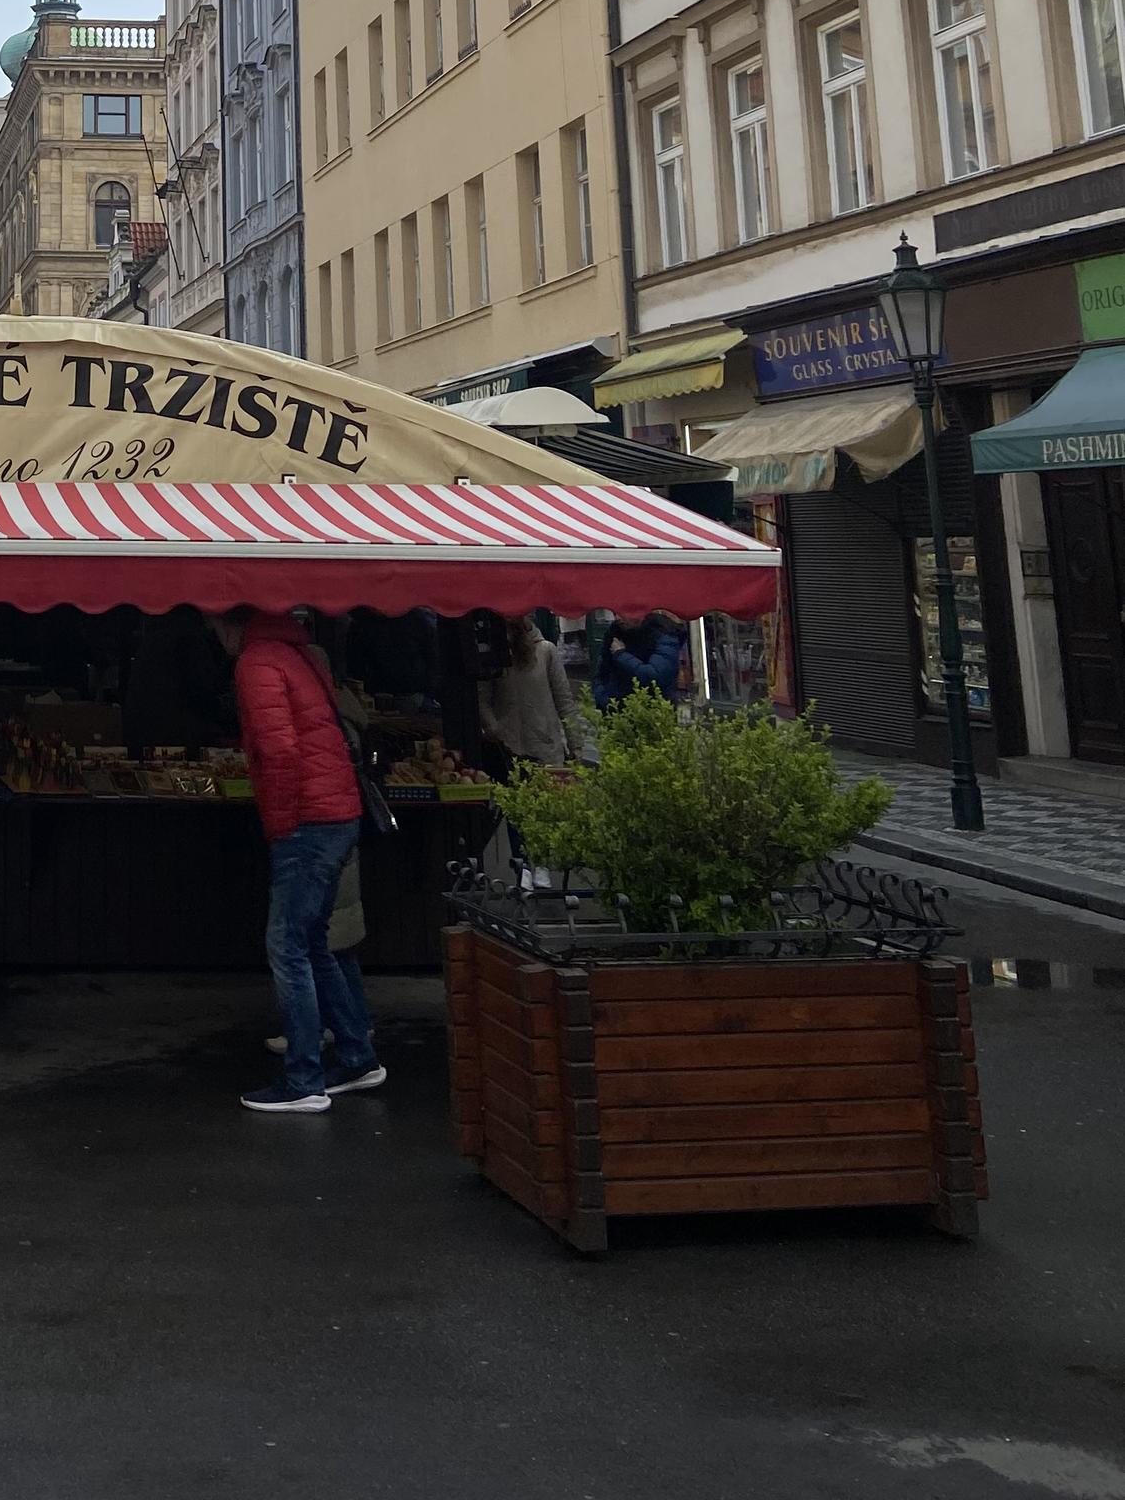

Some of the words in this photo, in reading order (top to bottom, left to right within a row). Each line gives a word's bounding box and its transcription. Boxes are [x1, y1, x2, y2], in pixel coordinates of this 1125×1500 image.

[763, 322, 864, 362] SOUVENIR
[792, 358, 834, 381] GLASS
[61, 356, 369, 474] TRŽIŠTĚ
[62, 437, 175, 481] 1232
